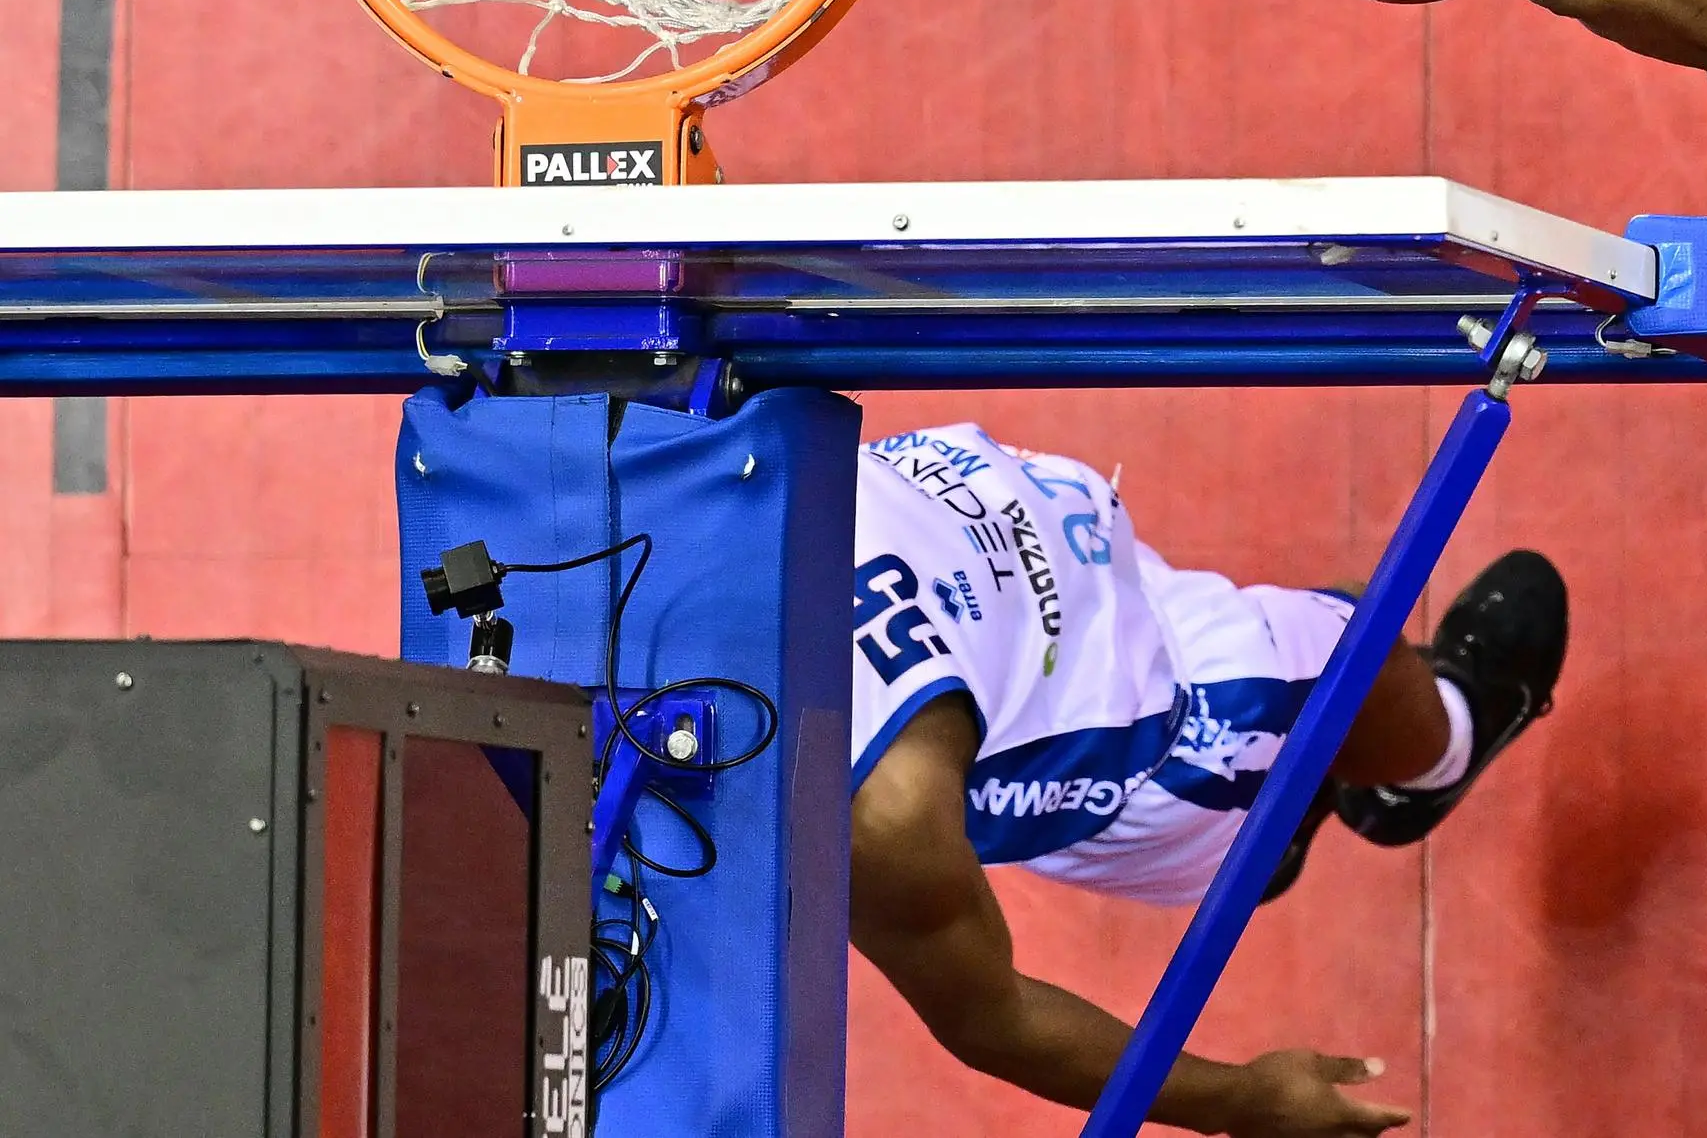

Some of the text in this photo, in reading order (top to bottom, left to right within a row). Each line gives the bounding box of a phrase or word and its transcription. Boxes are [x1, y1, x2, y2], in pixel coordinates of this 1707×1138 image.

[526, 149, 656, 183] PALLEX
[952, 569, 983, 622] errea
[1000, 498, 1061, 637] mazza
[853, 553, 952, 686] 55
